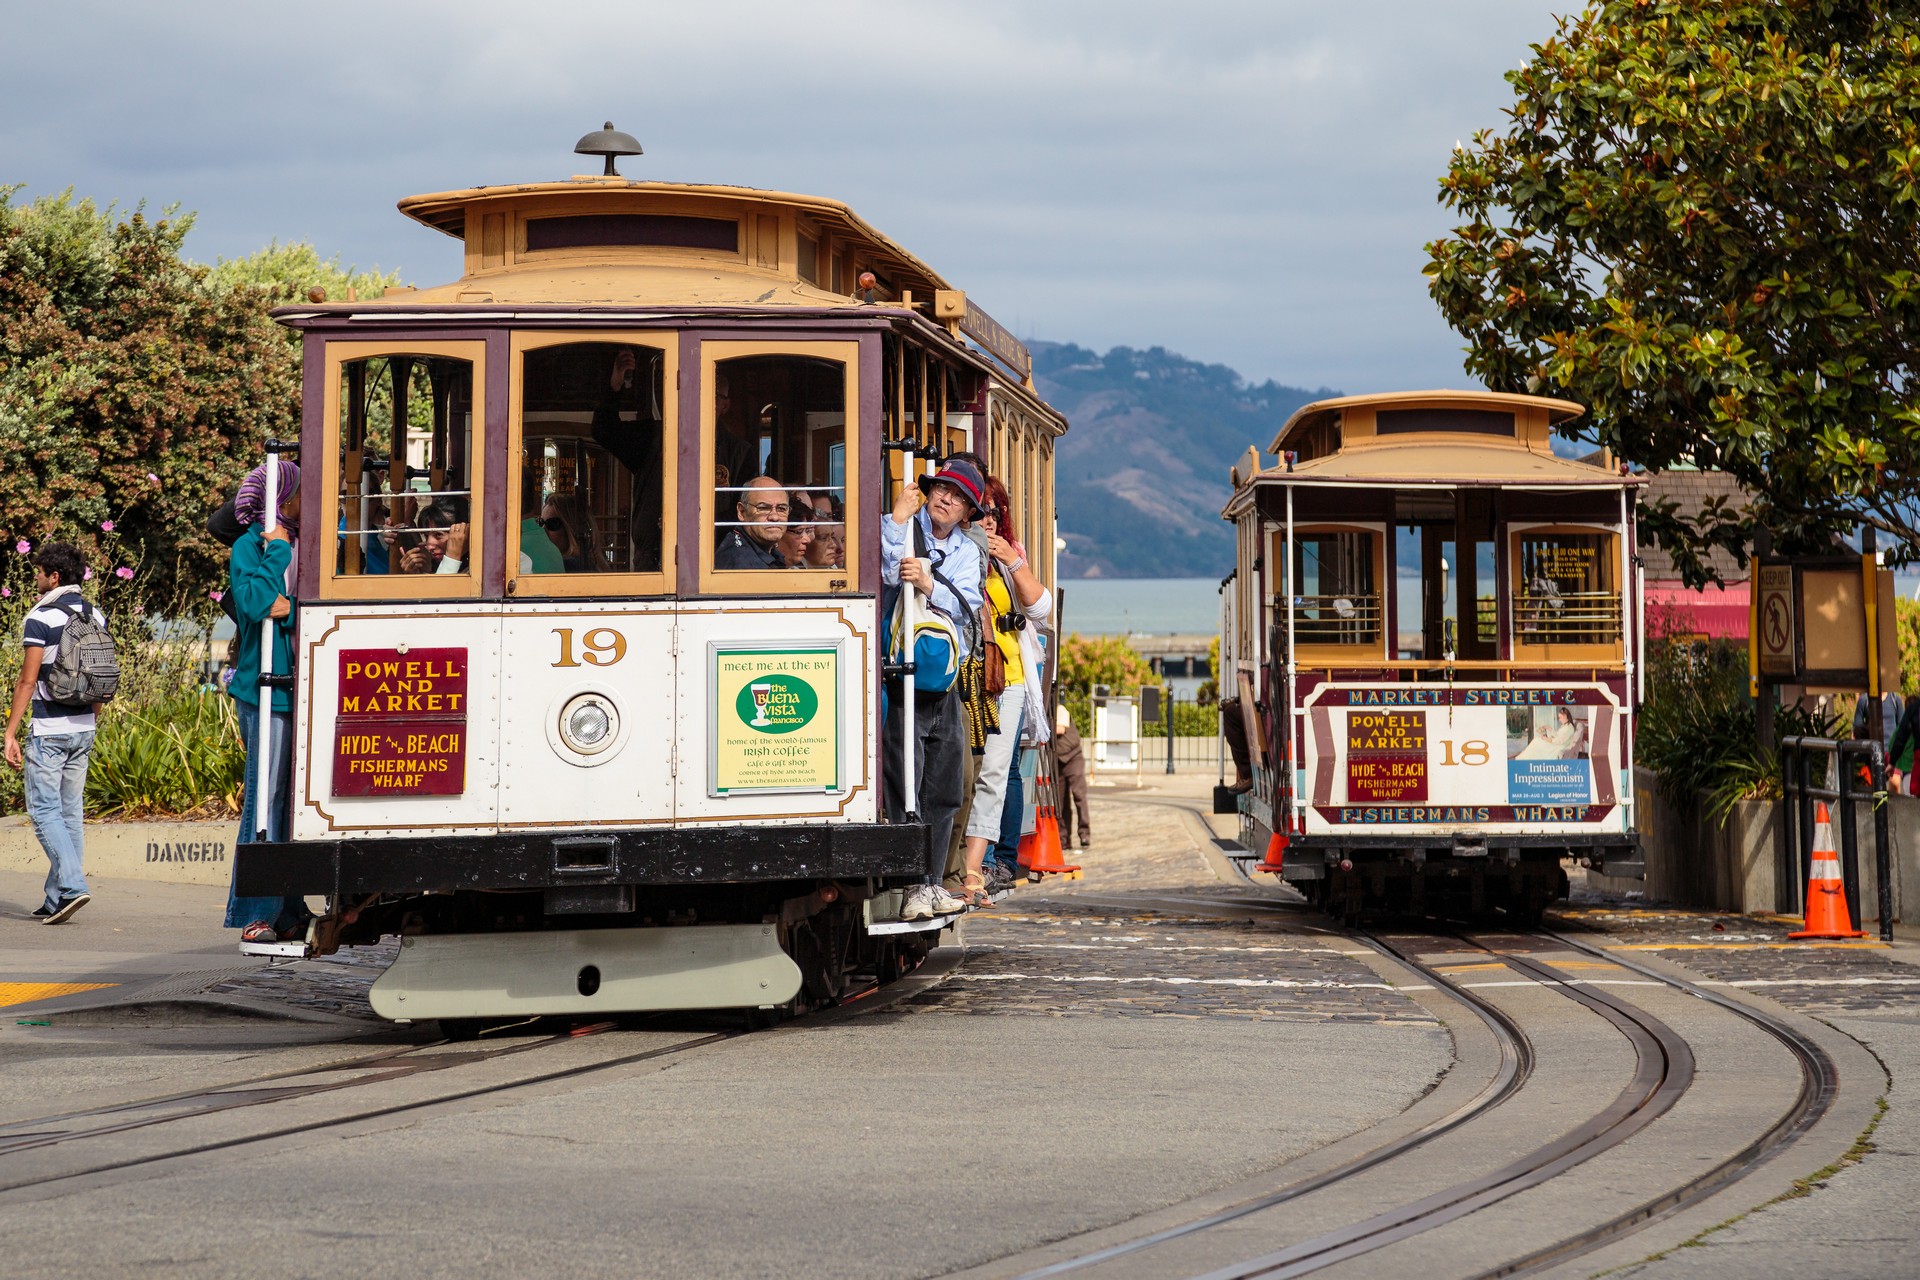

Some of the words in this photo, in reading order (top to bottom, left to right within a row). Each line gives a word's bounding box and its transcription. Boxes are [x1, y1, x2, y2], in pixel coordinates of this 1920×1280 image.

[999, 330, 1016, 362] HYDE
[560, 457, 576, 467] ONE
[1568, 547, 1580, 557] ONE
[1582, 547, 1596, 557] WAY
[1761, 570, 1777, 585] KEEP
[1778, 570, 1790, 585] OUT
[551, 627, 628, 668] 19
[346, 661, 460, 679] POWELL
[724, 660, 754, 671] meet
[756, 662, 774, 670] me
[776, 661, 789, 670] at
[791, 660, 811, 670] the
[376, 680, 433, 693] AND
[771, 684, 788, 692] the
[342, 693, 463, 712] MARKET
[1348, 689, 1443, 705] MARKET
[1465, 689, 1555, 705] STREET
[1565, 689, 1577, 705] &
[1352, 716, 1423, 728] POWELL
[1371, 728, 1406, 737] AND
[340, 735, 381, 755] HYDE
[385, 736, 404, 754] AND
[407, 733, 460, 754] BEACH
[727, 738, 747, 746] home
[749, 737, 758, 745] of
[1351, 737, 1425, 748] MARKET
[773, 745, 811, 756] coffee
[1439, 740, 1490, 766] 18
[350, 759, 448, 774] FISHERMANS
[788, 758, 808, 767] shop
[1529, 762, 1570, 773] Intimate
[1351, 763, 1376, 777] HYDE
[1379, 764, 1391, 776] AND
[1392, 763, 1424, 777] BEACH
[373, 774, 424, 788] WHARF
[1357, 778, 1418, 789] FISHERMANS
[1514, 772, 1584, 786] Impressionism
[1372, 788, 1403, 798] WHARF
[1548, 791, 1565, 800] Legion
[1341, 807, 1490, 823] FISHERMANS
[1512, 807, 1589, 823] WHARF
[146, 843, 225, 862] DANGER
